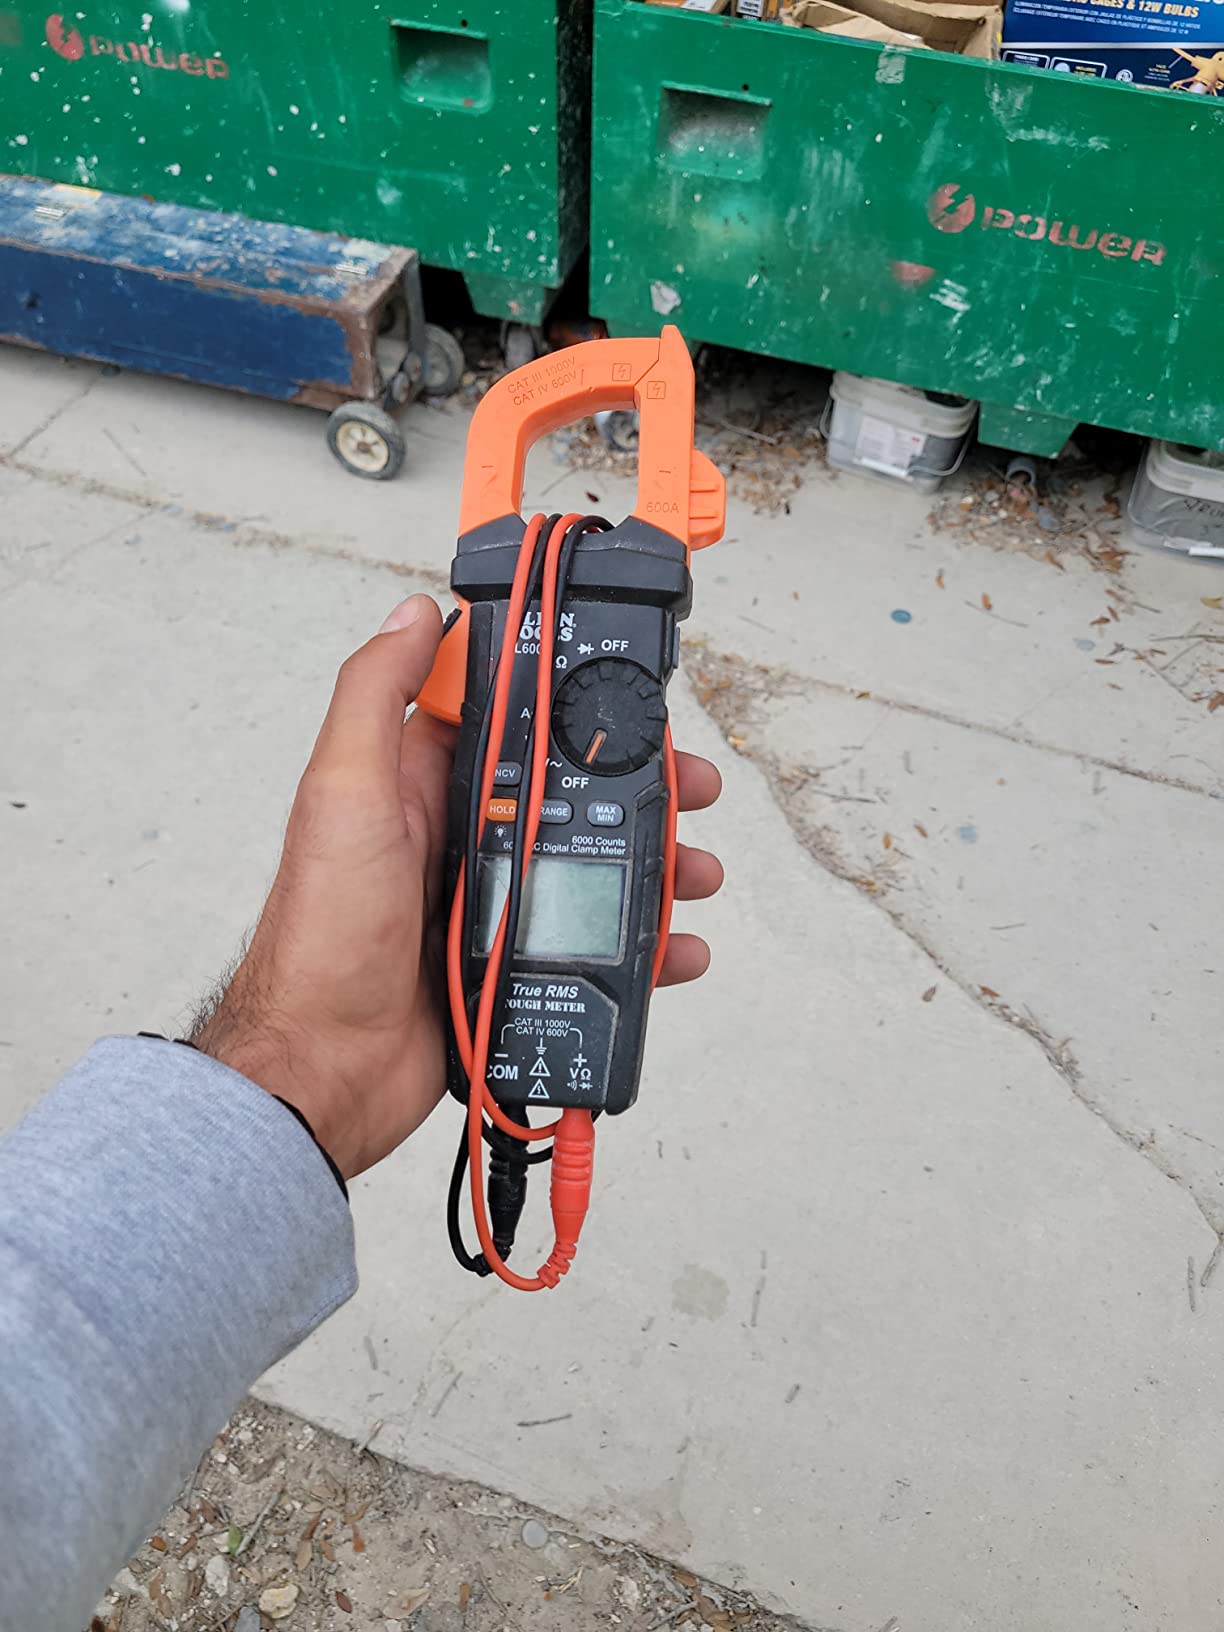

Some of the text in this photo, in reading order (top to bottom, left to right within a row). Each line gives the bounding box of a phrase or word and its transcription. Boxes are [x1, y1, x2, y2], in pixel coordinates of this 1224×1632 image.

[1126, 0, 1135, 10] &
[1138, 1, 1162, 13] 12W
[1163, 4, 1200, 18] BULBS
[507, 355, 576, 394] CAT III 1000V
[513, 369, 577, 406] CAT IV 600V
[646, 501, 680, 514] 600A
[601, 639, 629, 652] OFF
[494, 768, 516, 778] NCV
[561, 776, 590, 789] OFF
[489, 805, 516, 815] HOLD
[540, 806, 568, 817] RANGE
[595, 805, 617, 815] MAX
[597, 814, 615, 822] MIN
[572, 835, 626, 847] 6000 Counts
[543, 842, 569, 854] Digital
[571, 844, 598, 856] Clamp
[600, 846, 626, 856] Meter
[513, 983, 579, 999] True RMS
[545, 1000, 586, 1013] METER
[514, 1017, 571, 1029] CAT III 1000V
[516, 1026, 569, 1038] CAT IV 600V
